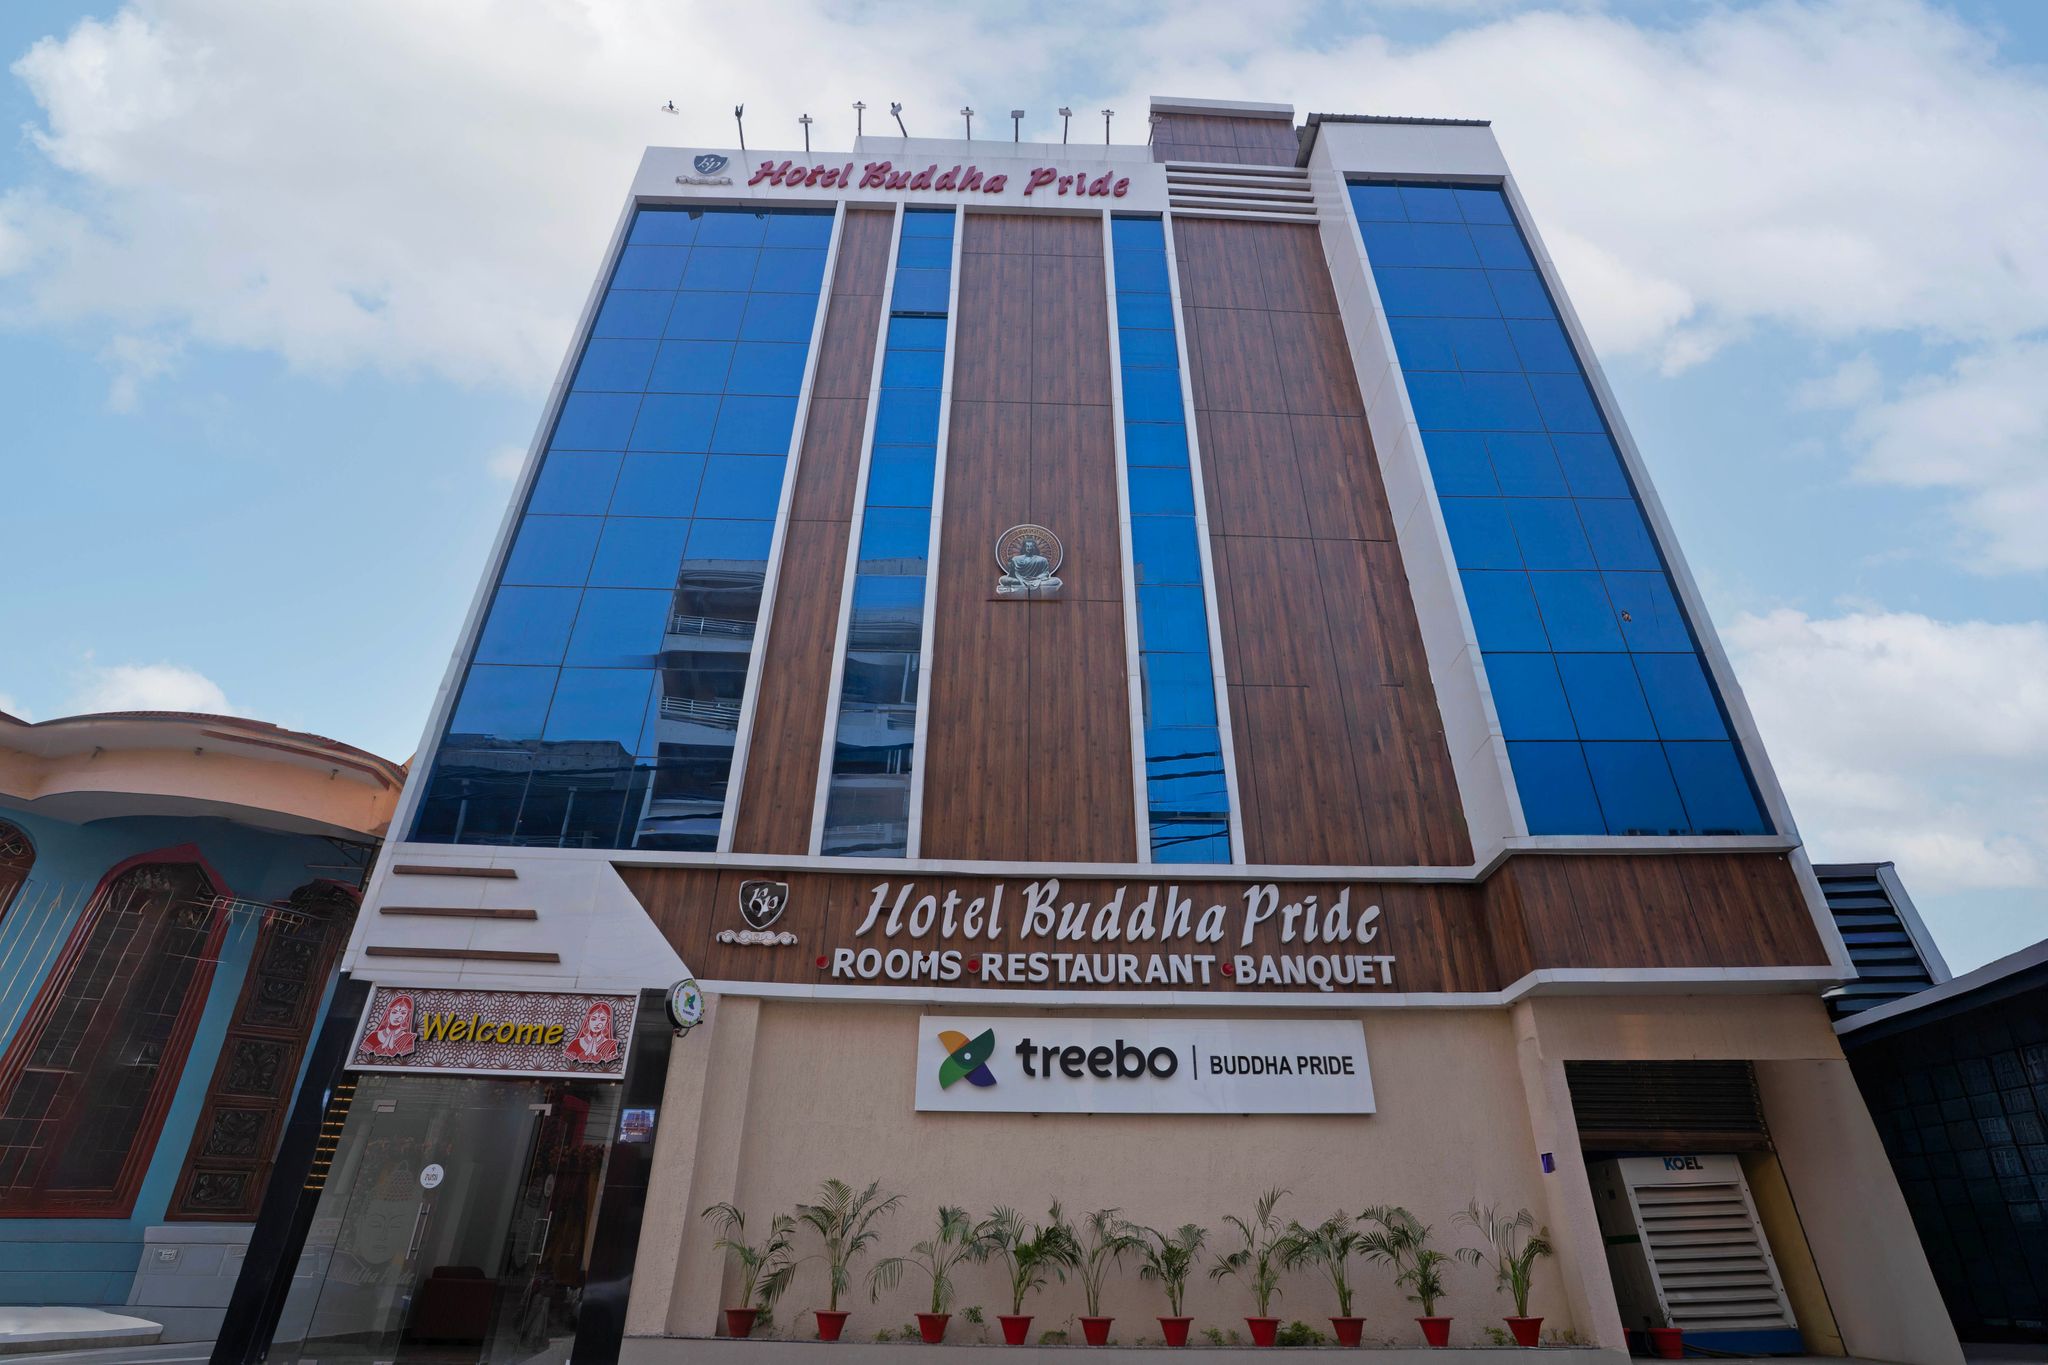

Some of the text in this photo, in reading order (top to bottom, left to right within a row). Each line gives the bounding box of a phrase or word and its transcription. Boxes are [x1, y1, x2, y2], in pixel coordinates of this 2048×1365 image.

[748, 160, 1130, 198] Hotel Buddha Pride
[855, 878, 1381, 949] Hotel Buddha Pride
[831, 947, 1396, 992] ROOMS RESTAURANT BANQUET
[421, 1012, 565, 1046] Welcome
[1015, 1037, 1356, 1079] treebo BUDDHA PRIDE
[1662, 1155, 1704, 1171] KOEL
